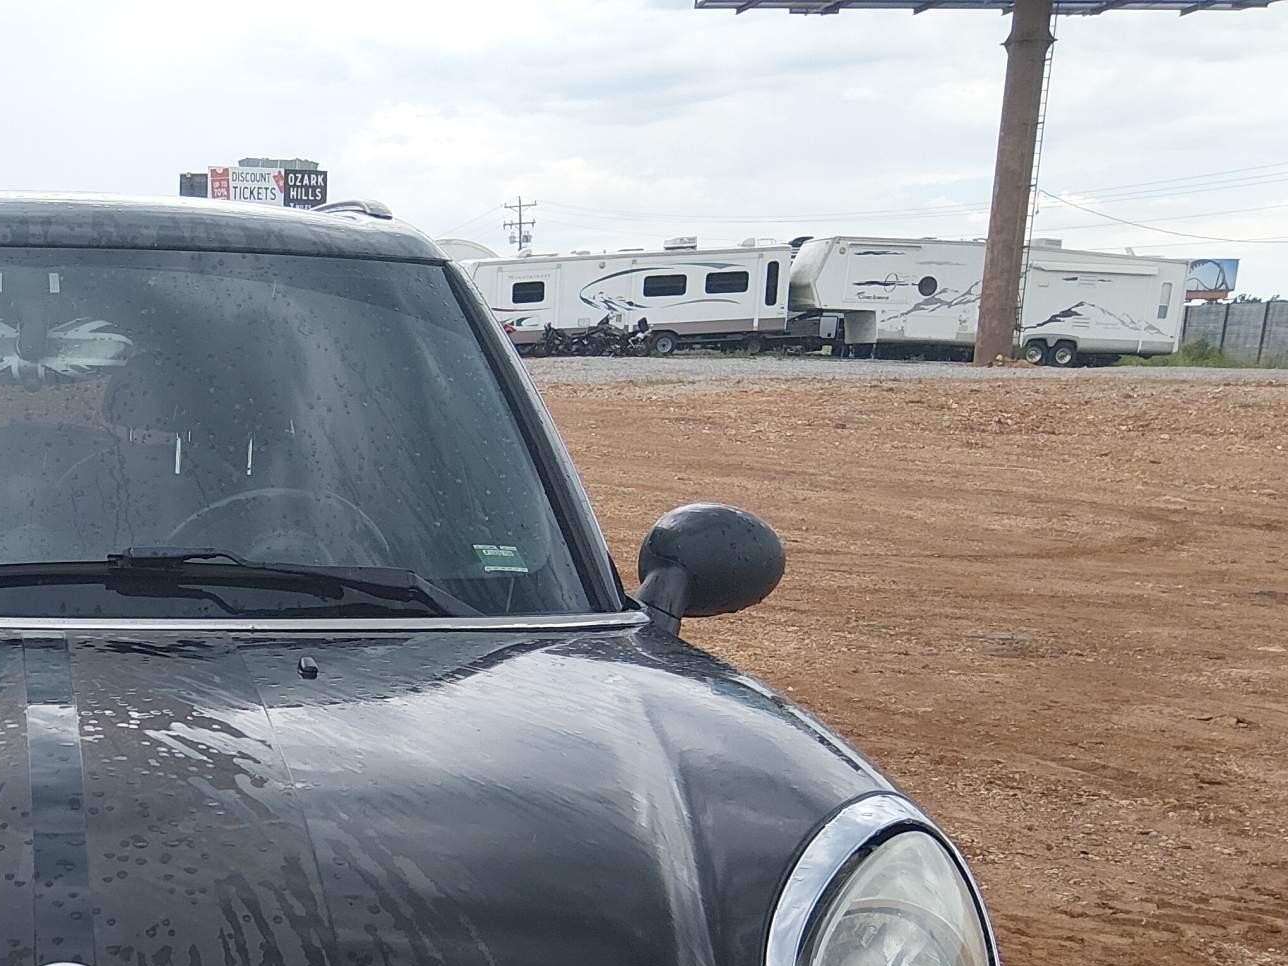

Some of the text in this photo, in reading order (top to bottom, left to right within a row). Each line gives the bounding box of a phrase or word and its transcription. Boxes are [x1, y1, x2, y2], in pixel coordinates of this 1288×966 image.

[232, 172, 271, 183] DISCOUNT
[288, 174, 324, 186] OZARK
[232, 186, 277, 201] TICKETS
[289, 187, 322, 200] HILLS
